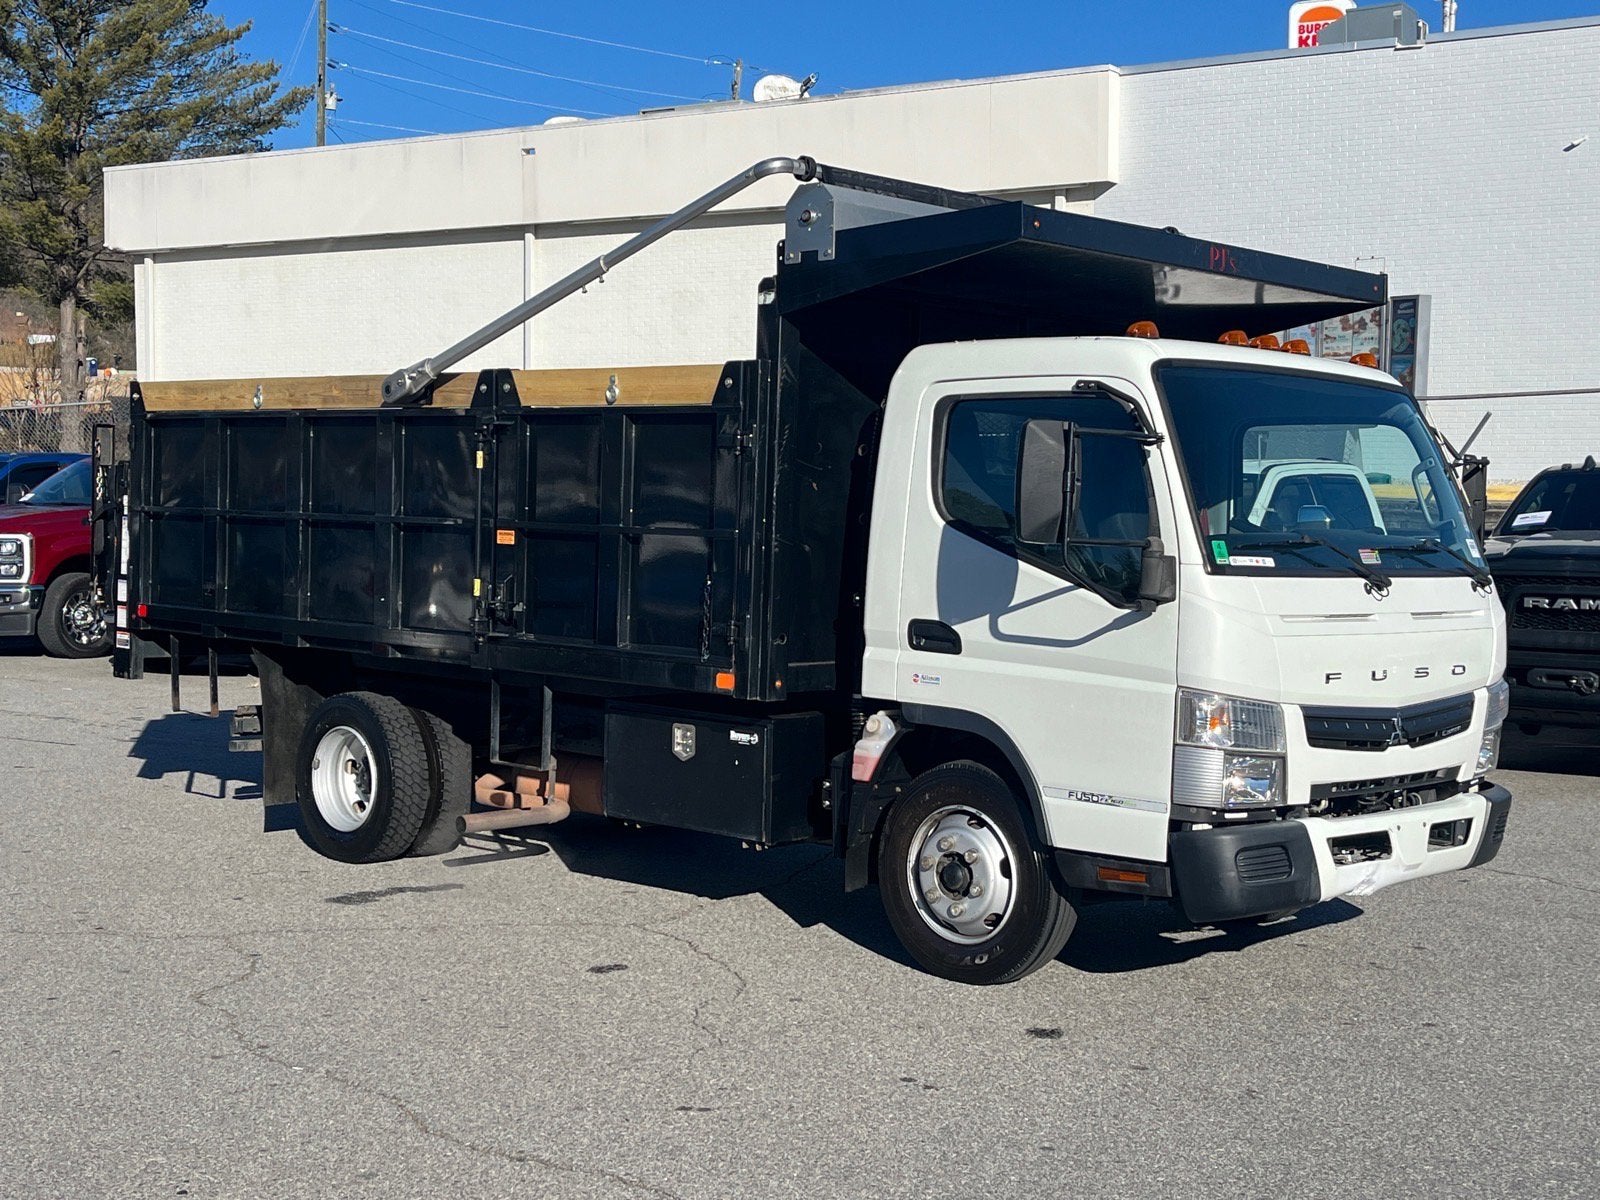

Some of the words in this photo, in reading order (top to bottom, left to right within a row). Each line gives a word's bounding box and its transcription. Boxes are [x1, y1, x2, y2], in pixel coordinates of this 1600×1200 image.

[1298, 35, 1318, 48] KI
[1523, 597, 1600, 610] RAM
[1325, 664, 1466, 684] FUSO
[1068, 791, 1099, 803] FUSO
